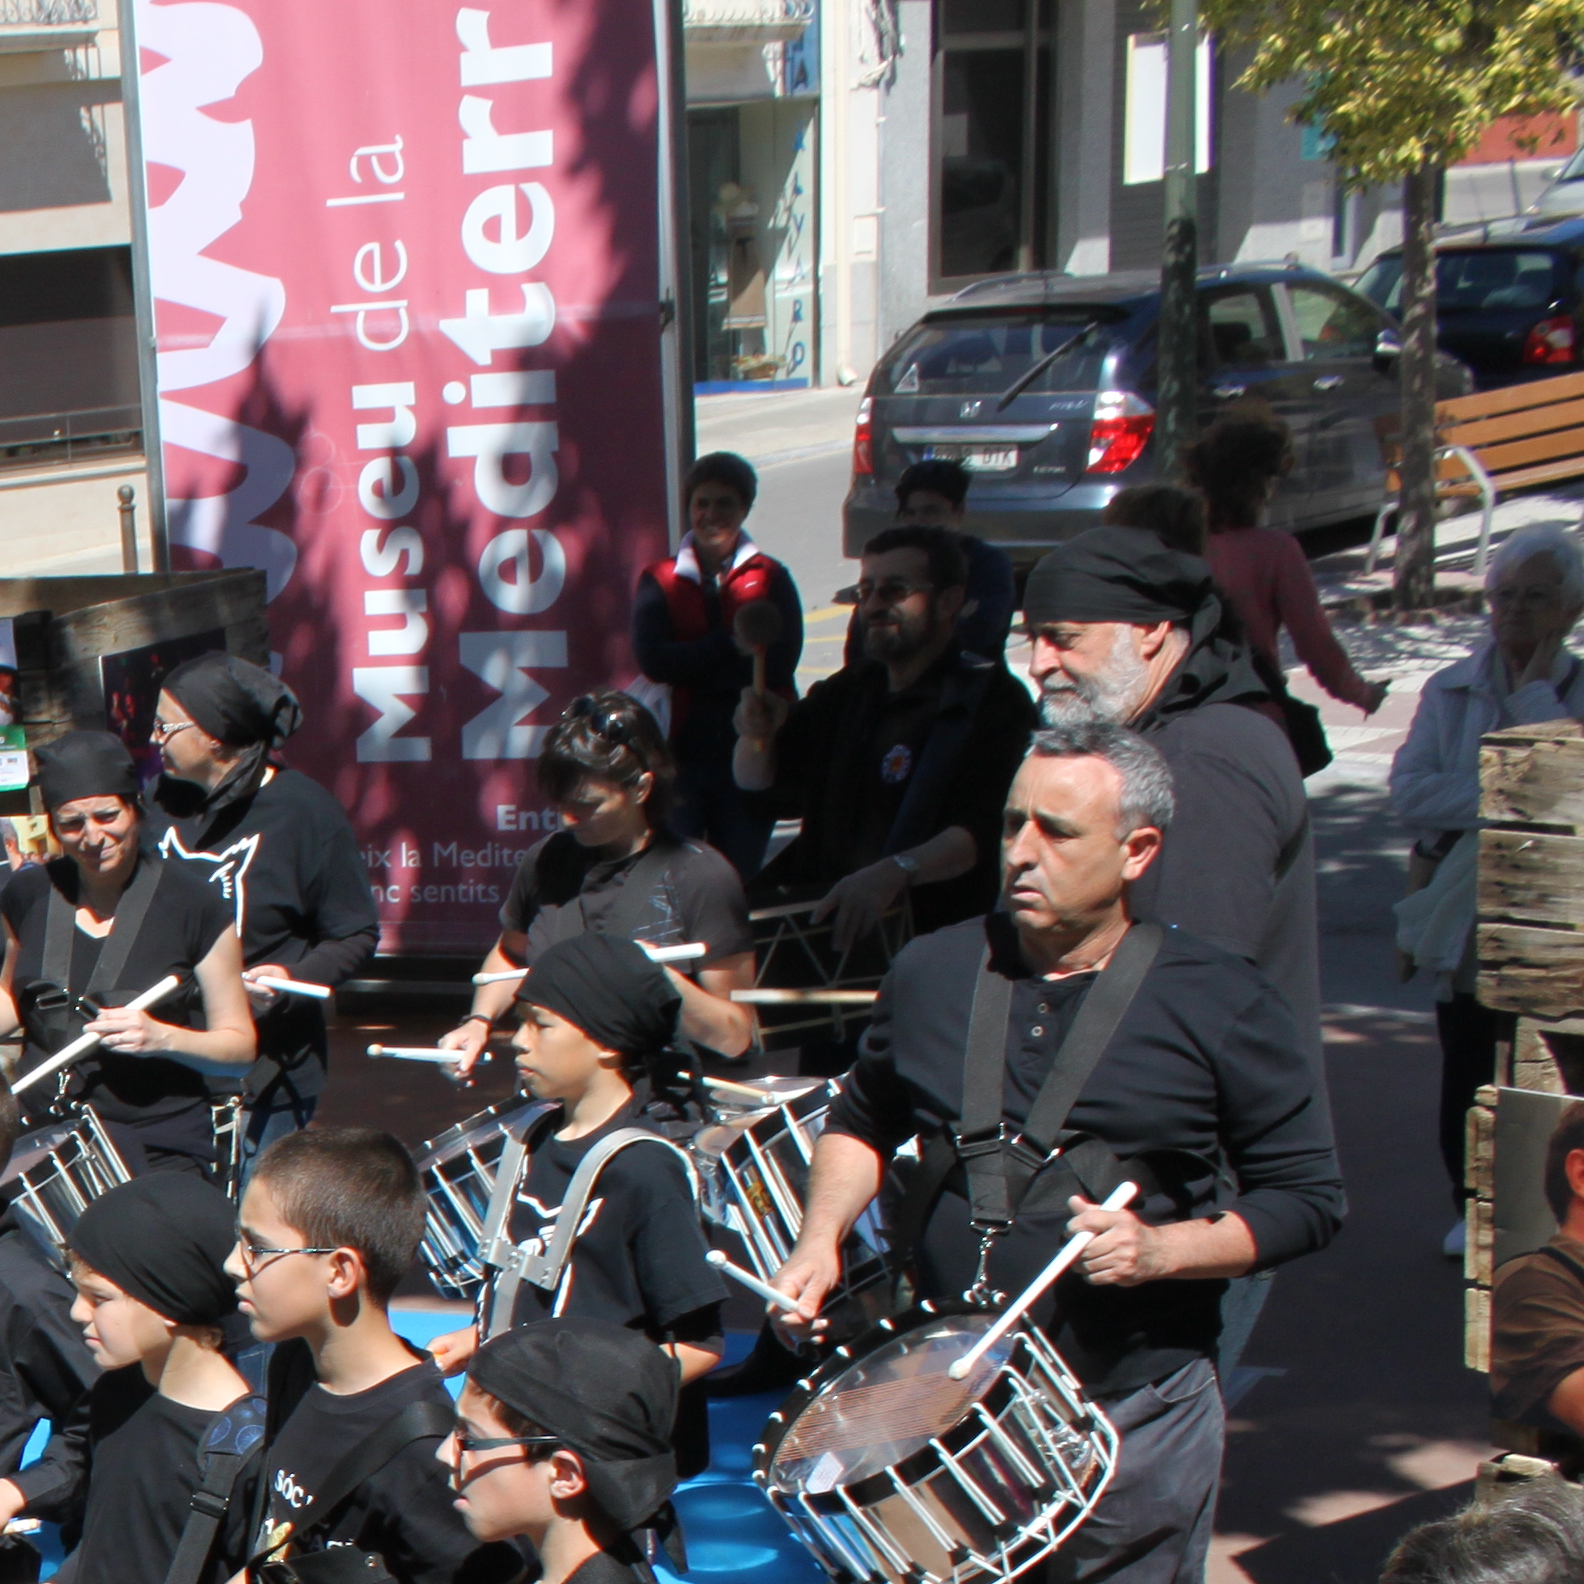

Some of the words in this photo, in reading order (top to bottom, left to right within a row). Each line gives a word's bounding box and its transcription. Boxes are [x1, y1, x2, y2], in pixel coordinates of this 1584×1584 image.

[325, 134, 405, 207] la
[330, 238, 410, 352] de
[353, 381, 430, 763] Museu
[401, 841, 422, 868] la
[410, 878, 500, 903] sentits
